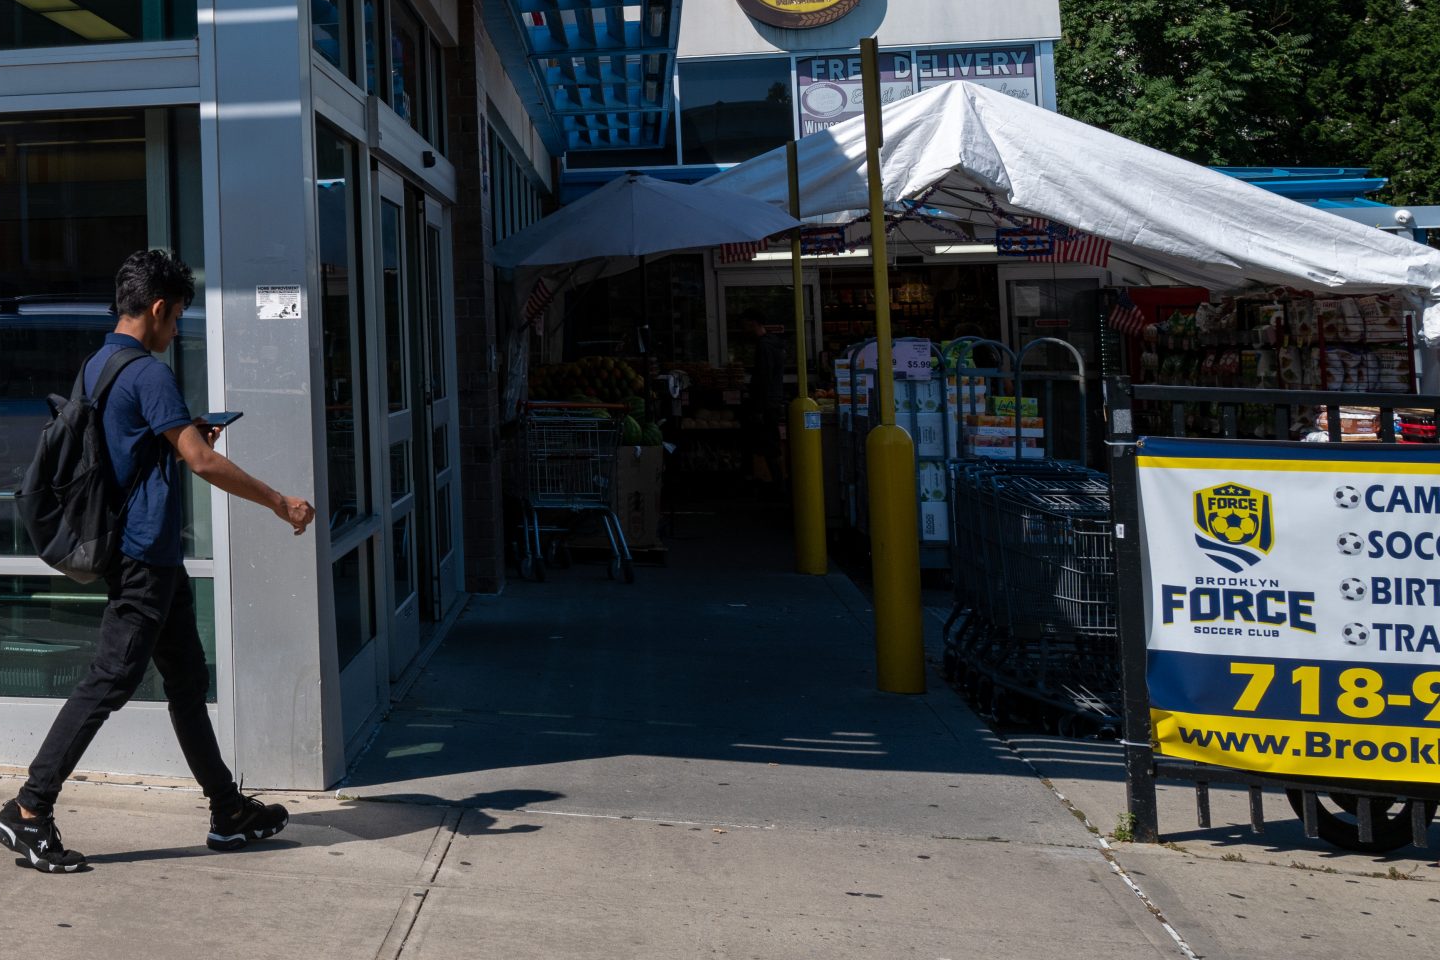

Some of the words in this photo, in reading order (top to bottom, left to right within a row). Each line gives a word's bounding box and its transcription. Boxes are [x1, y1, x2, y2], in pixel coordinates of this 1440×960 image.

[811, 57, 862, 82] FRE
[894, 51, 1028, 80] DELIVERY
[907, 360, 932, 369] $5.99
[1208, 496, 1258, 512] FORCE
[1364, 484, 1440, 514] CAM
[1367, 530, 1440, 561] SOC
[1195, 576, 1280, 588] BROOKLYN
[1371, 576, 1440, 607] BIRT
[1162, 584, 1317, 634] FORCE
[1194, 626, 1243, 636] SOCCER
[1248, 628, 1280, 638] CLUB
[1371, 622, 1440, 653] TRA
[1178, 726, 1440, 766] www.Brook
